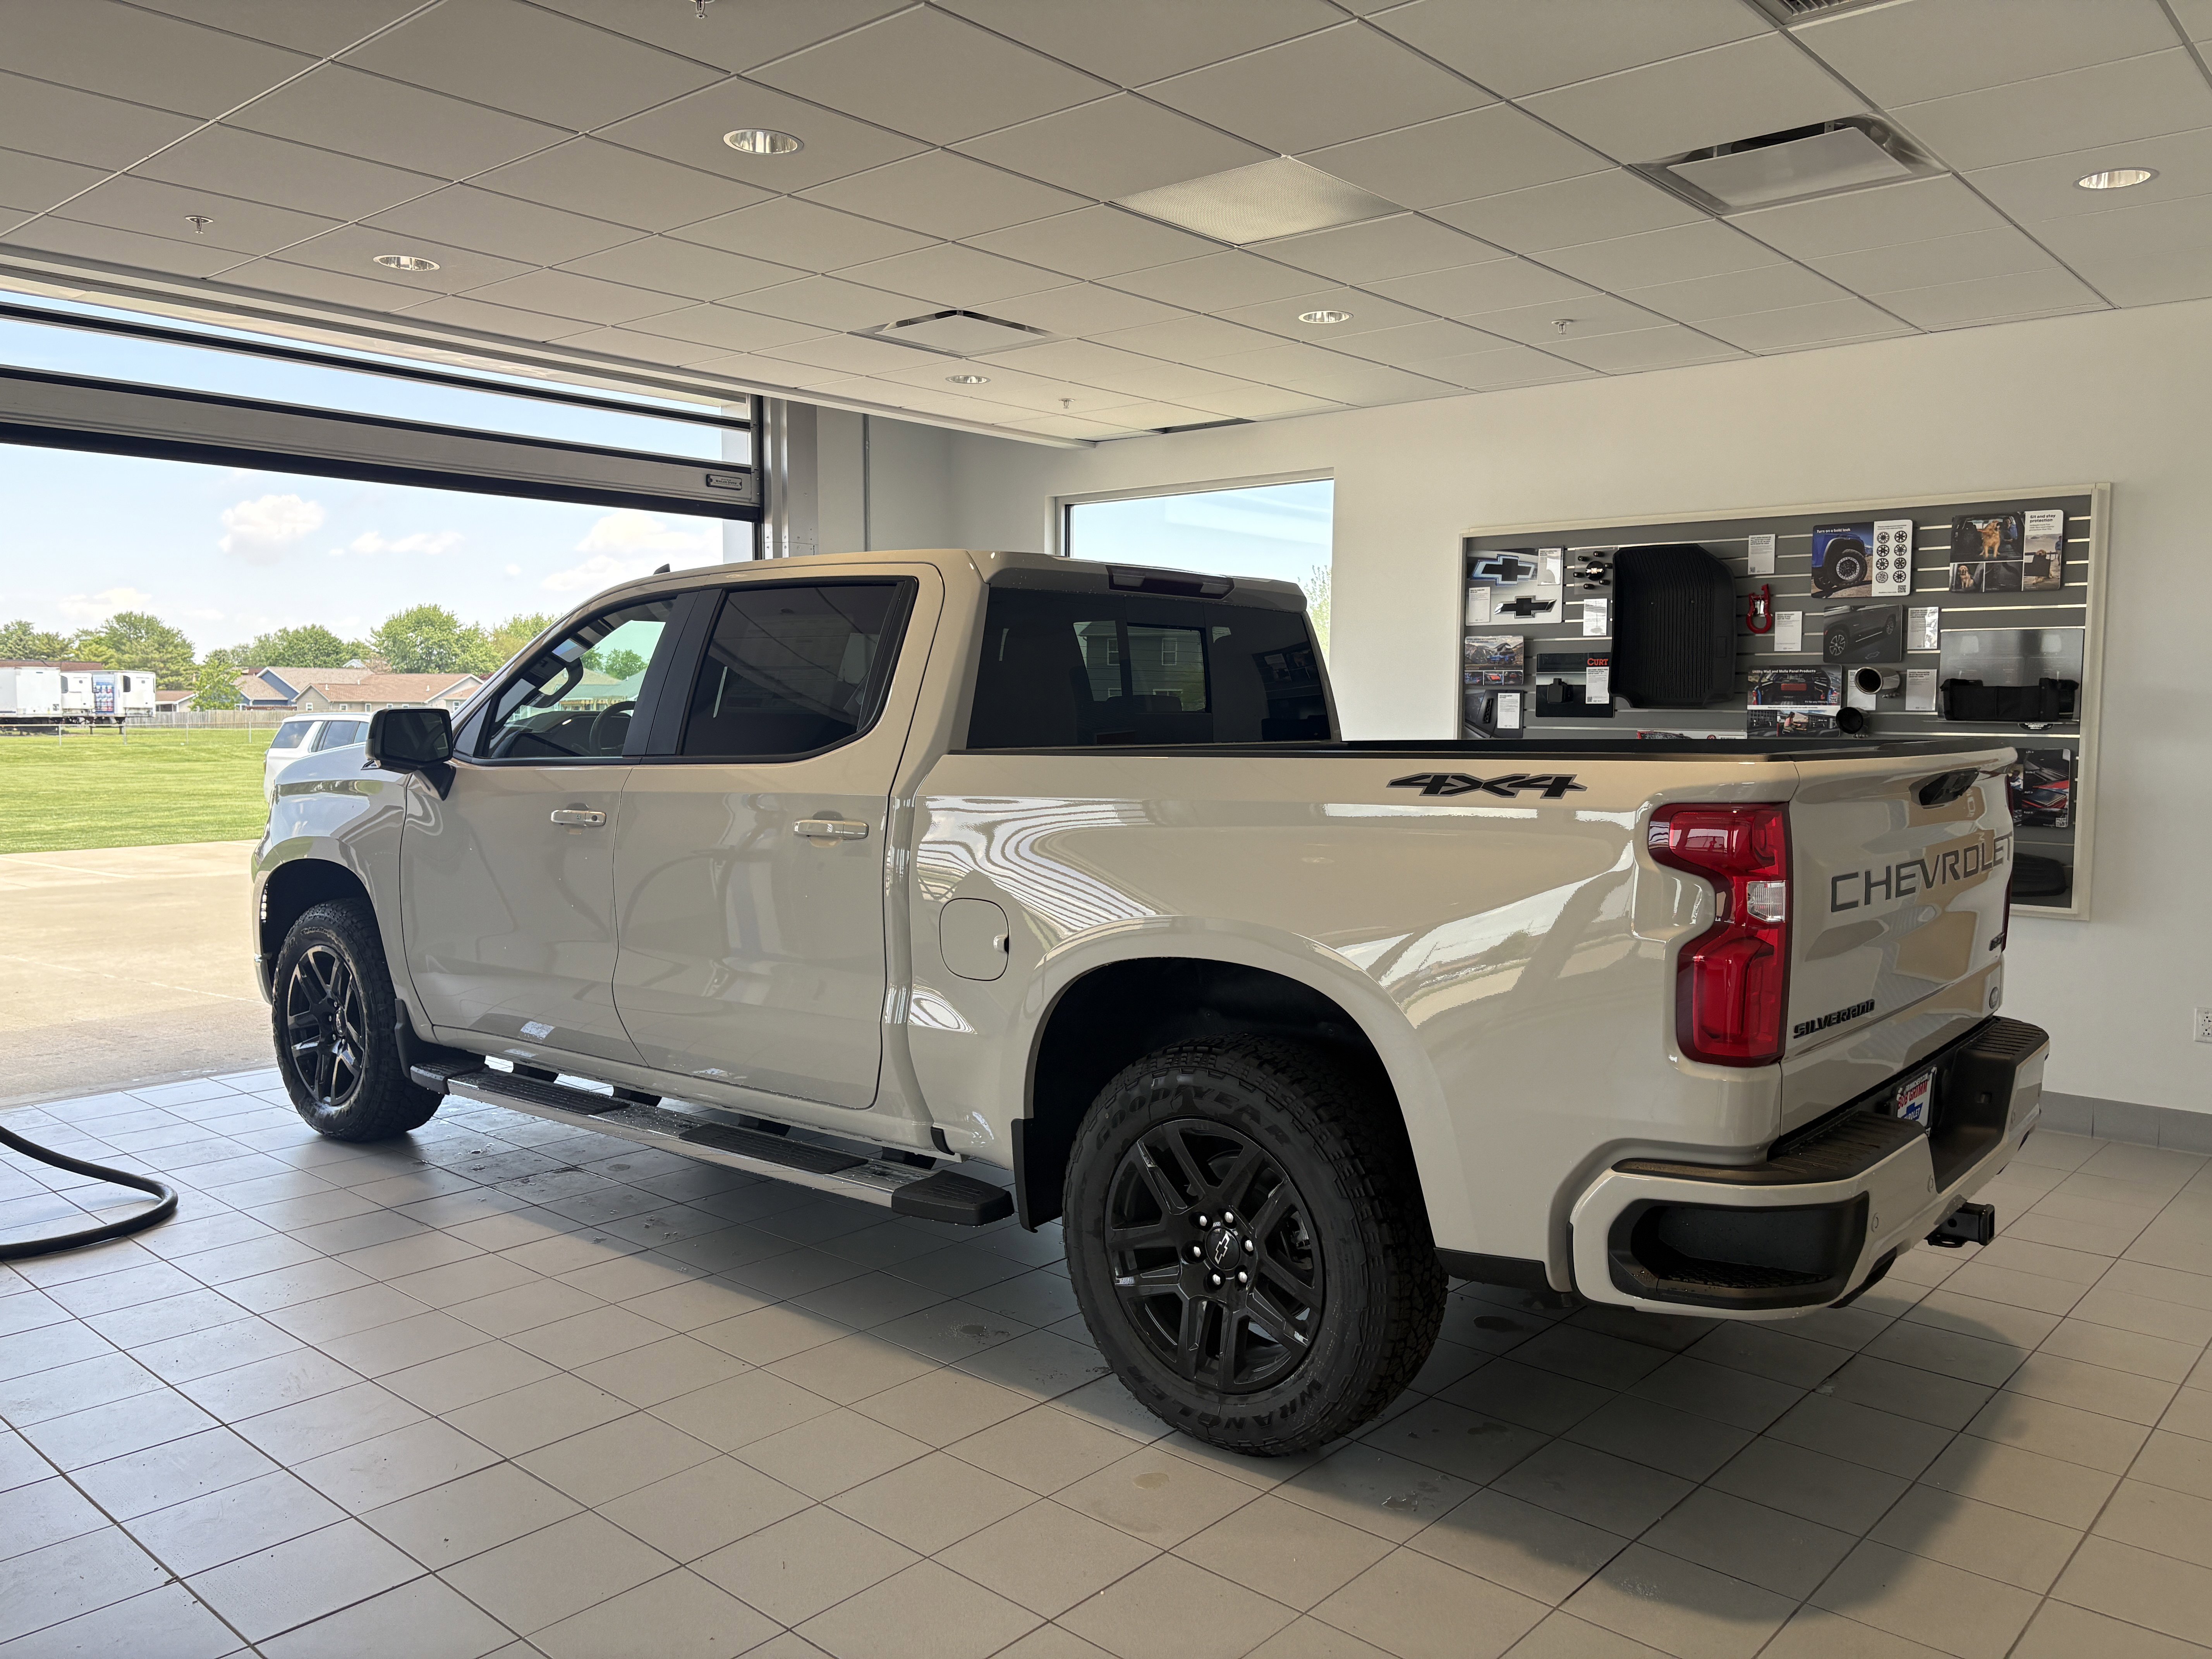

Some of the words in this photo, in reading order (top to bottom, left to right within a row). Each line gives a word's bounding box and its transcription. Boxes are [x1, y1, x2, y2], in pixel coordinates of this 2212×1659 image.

[1587, 658, 1609, 666] CURT
[1831, 832, 2013, 913] CHEVROLET
[1793, 998, 1875, 1039] SILVERADO
[1096, 1084, 1291, 1151] GOODYEAR
[1898, 1093, 1908, 1110] BOB
[1909, 1081, 1928, 1102] GRIMM
[1127, 1365, 1323, 1431] WRANGLER
